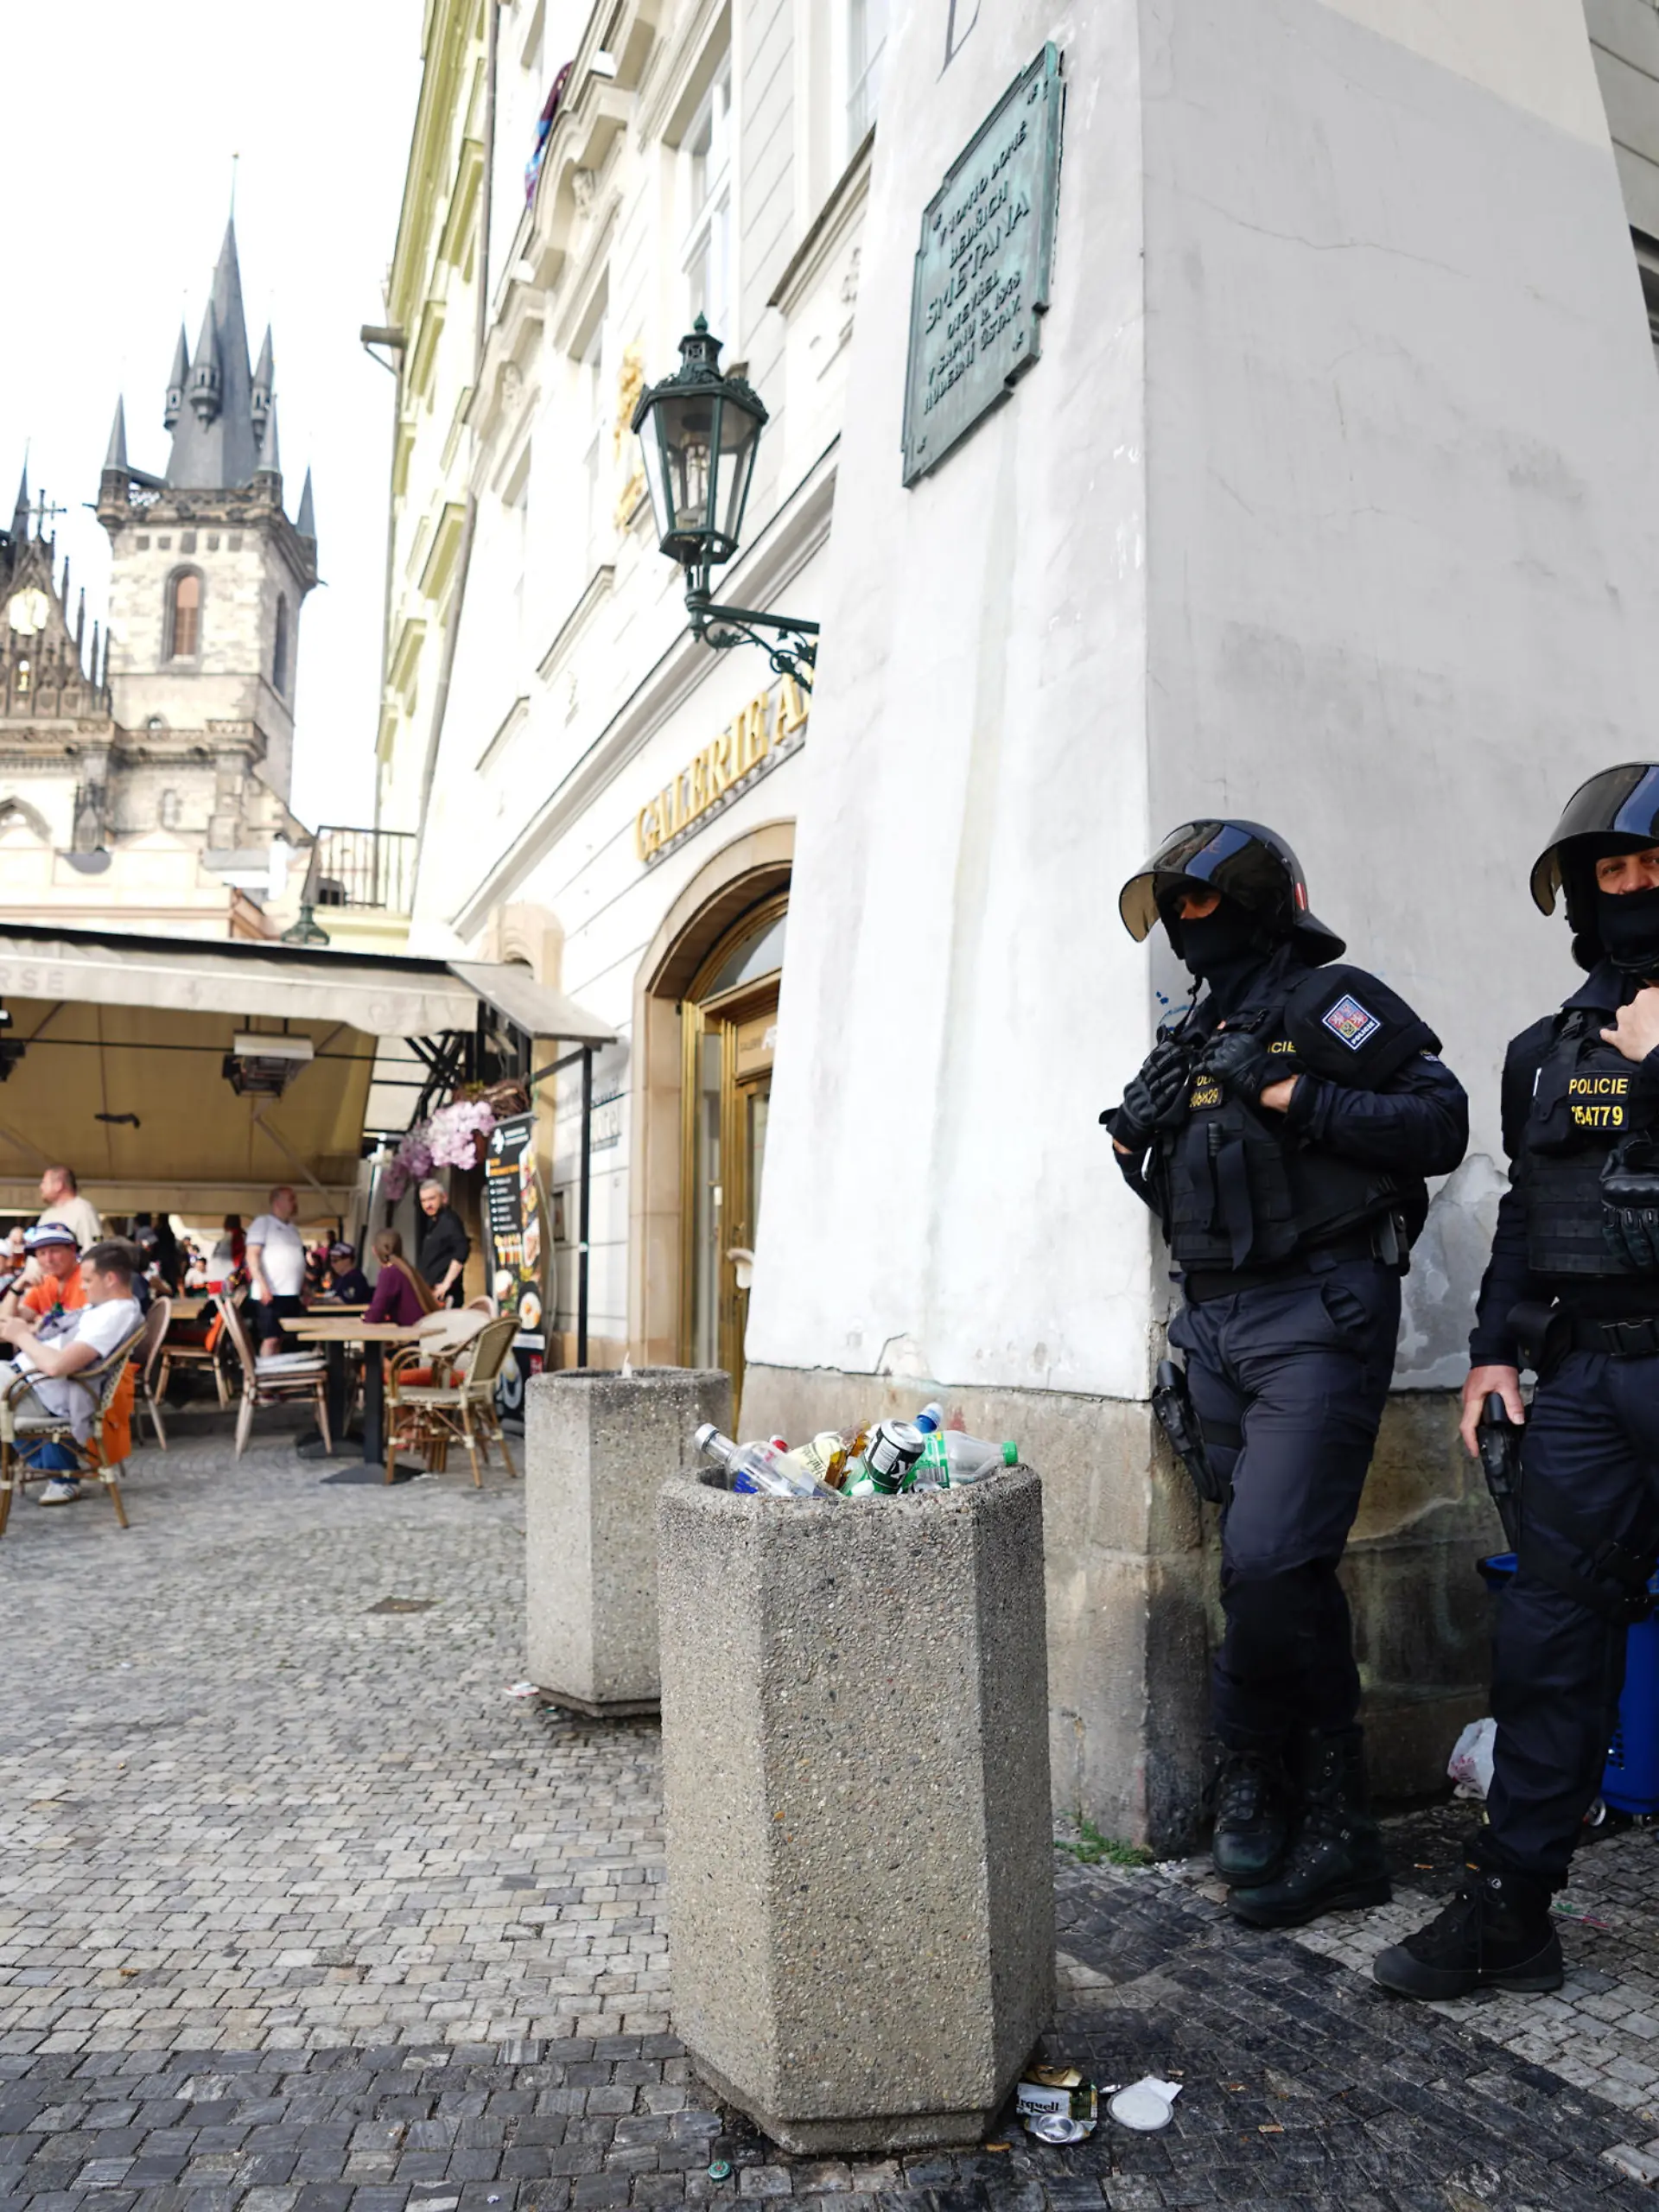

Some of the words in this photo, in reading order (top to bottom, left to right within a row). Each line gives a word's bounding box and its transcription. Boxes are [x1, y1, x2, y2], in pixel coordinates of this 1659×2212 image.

[925, 191, 1030, 335] SMETANA
[635, 691, 768, 861] GALERIE
[1351, 1020, 1376, 1045] POLICIE
[1568, 1077, 1629, 1095] POLICIE
